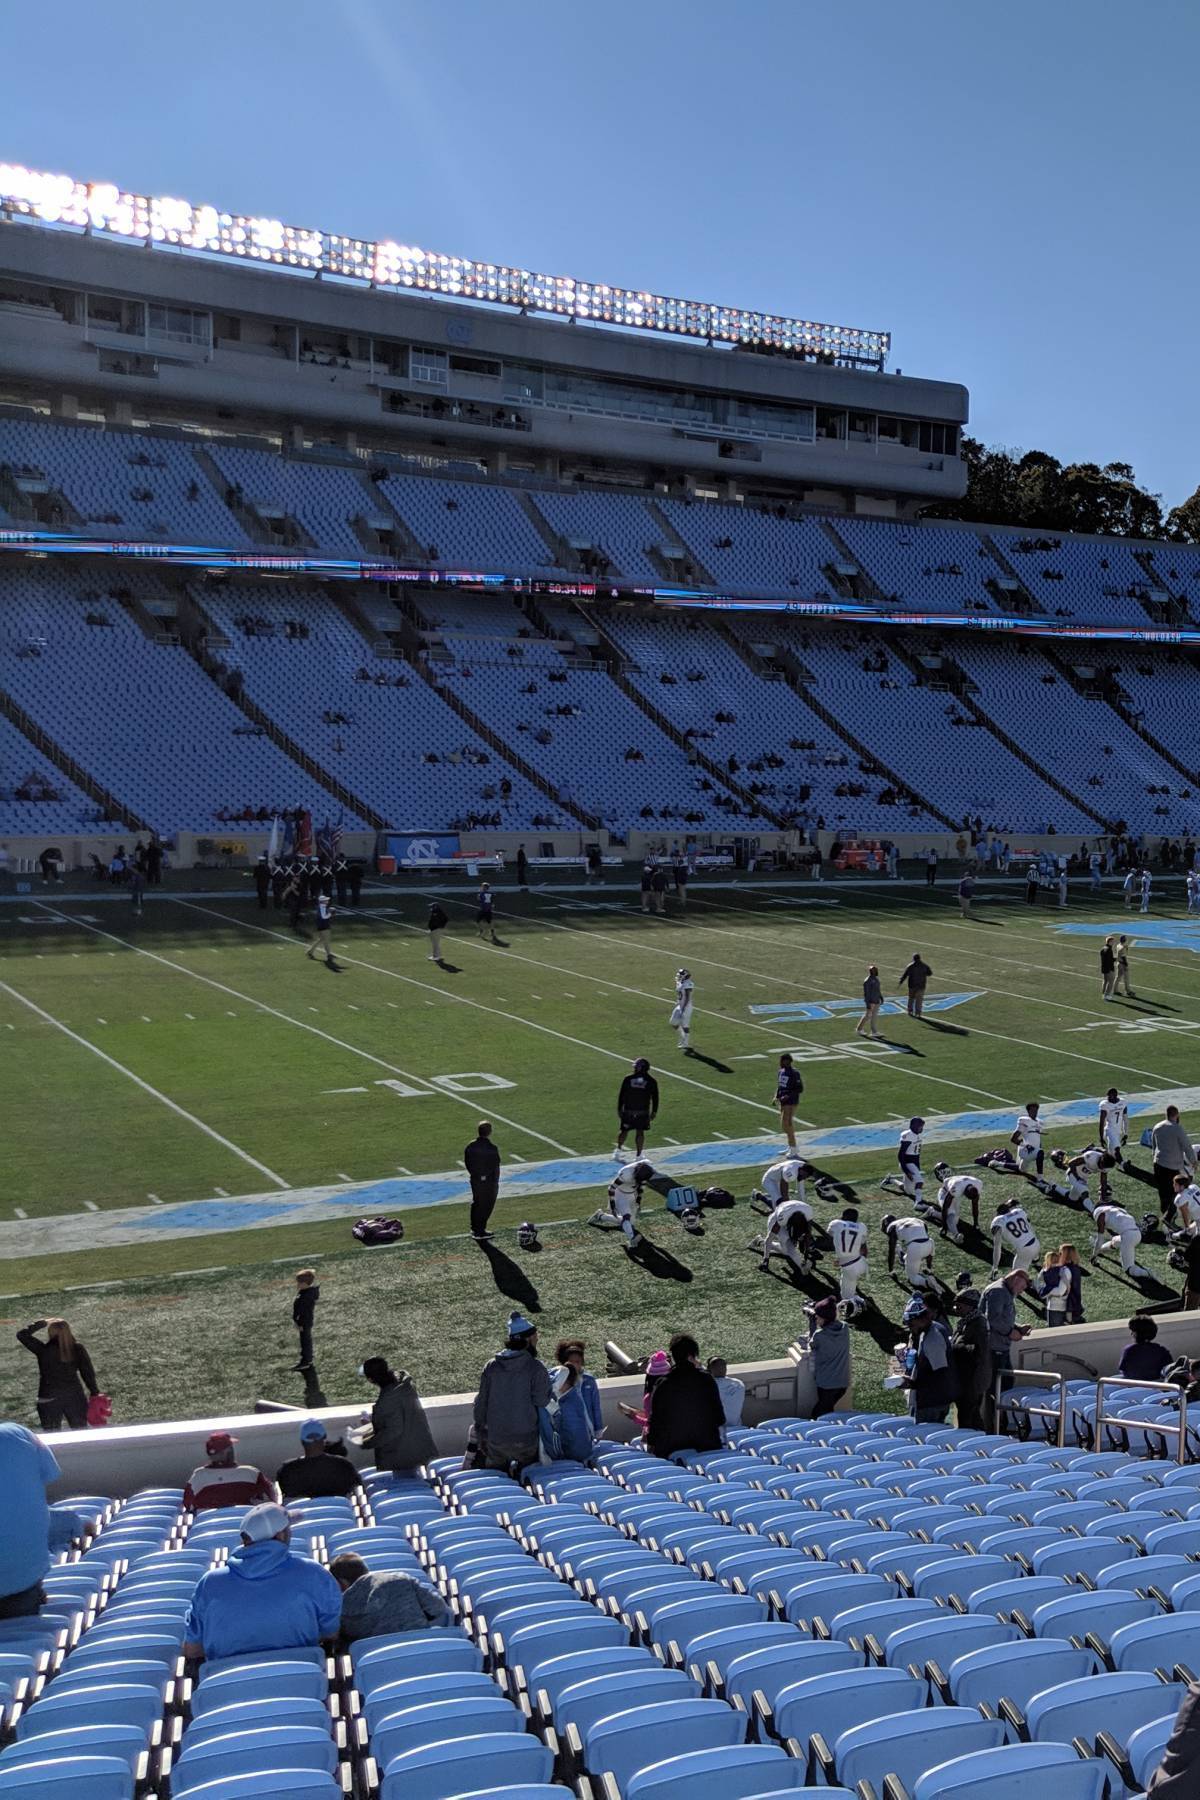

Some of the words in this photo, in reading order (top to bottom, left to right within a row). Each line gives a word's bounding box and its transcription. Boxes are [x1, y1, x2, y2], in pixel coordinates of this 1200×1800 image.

[374, 1072, 519, 1098] 10
[1114, 1111, 1120, 1124] 7
[675, 1188, 694, 1205] 10
[1006, 1217, 1030, 1238] 80
[841, 1229, 858, 1253] 17
